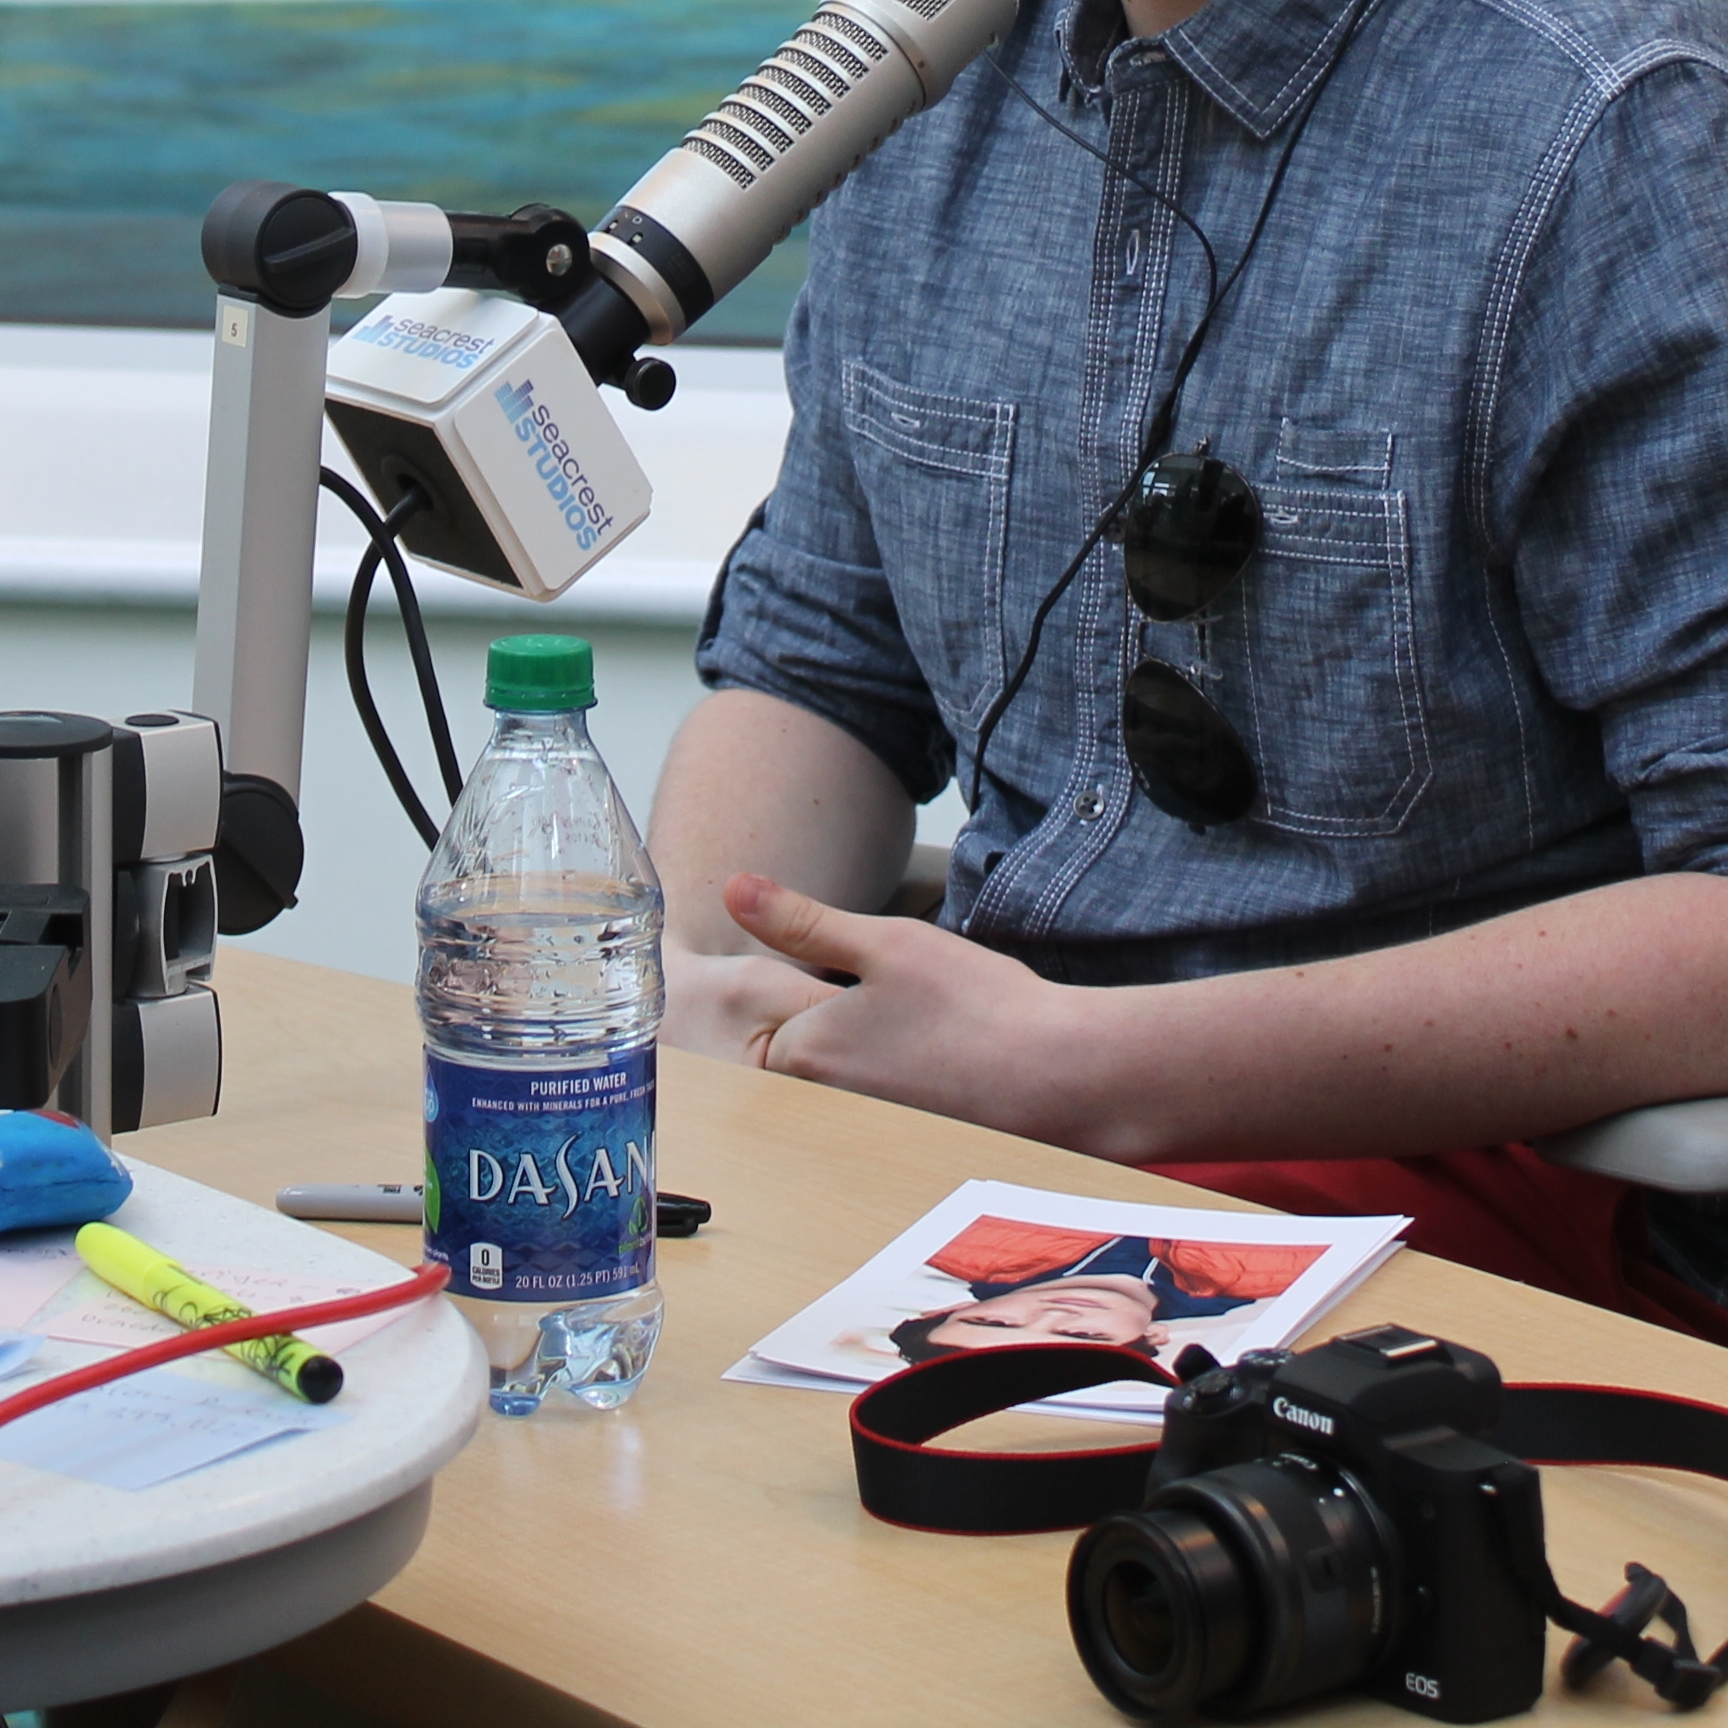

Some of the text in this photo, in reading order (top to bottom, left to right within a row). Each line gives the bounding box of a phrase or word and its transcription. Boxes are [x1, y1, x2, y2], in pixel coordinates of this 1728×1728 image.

[230, 322, 239, 338] 5
[394, 318, 495, 354] seacrest
[377, 332, 479, 369] STUDIOS
[515, 417, 598, 551] STUDIOS
[532, 405, 613, 536] seacrest
[531, 1072, 627, 1096] PURIFIED WATER
[472, 1096, 608, 1112] ENHANCED WITH MINERALS FOR A
[481, 1249, 490, 1266] 0
[515, 1268, 627, 1289] 20 FL OZ (1.25 PT) 591
[1272, 1396, 1335, 1437] Canon
[1406, 1672, 1441, 1700] EOS
